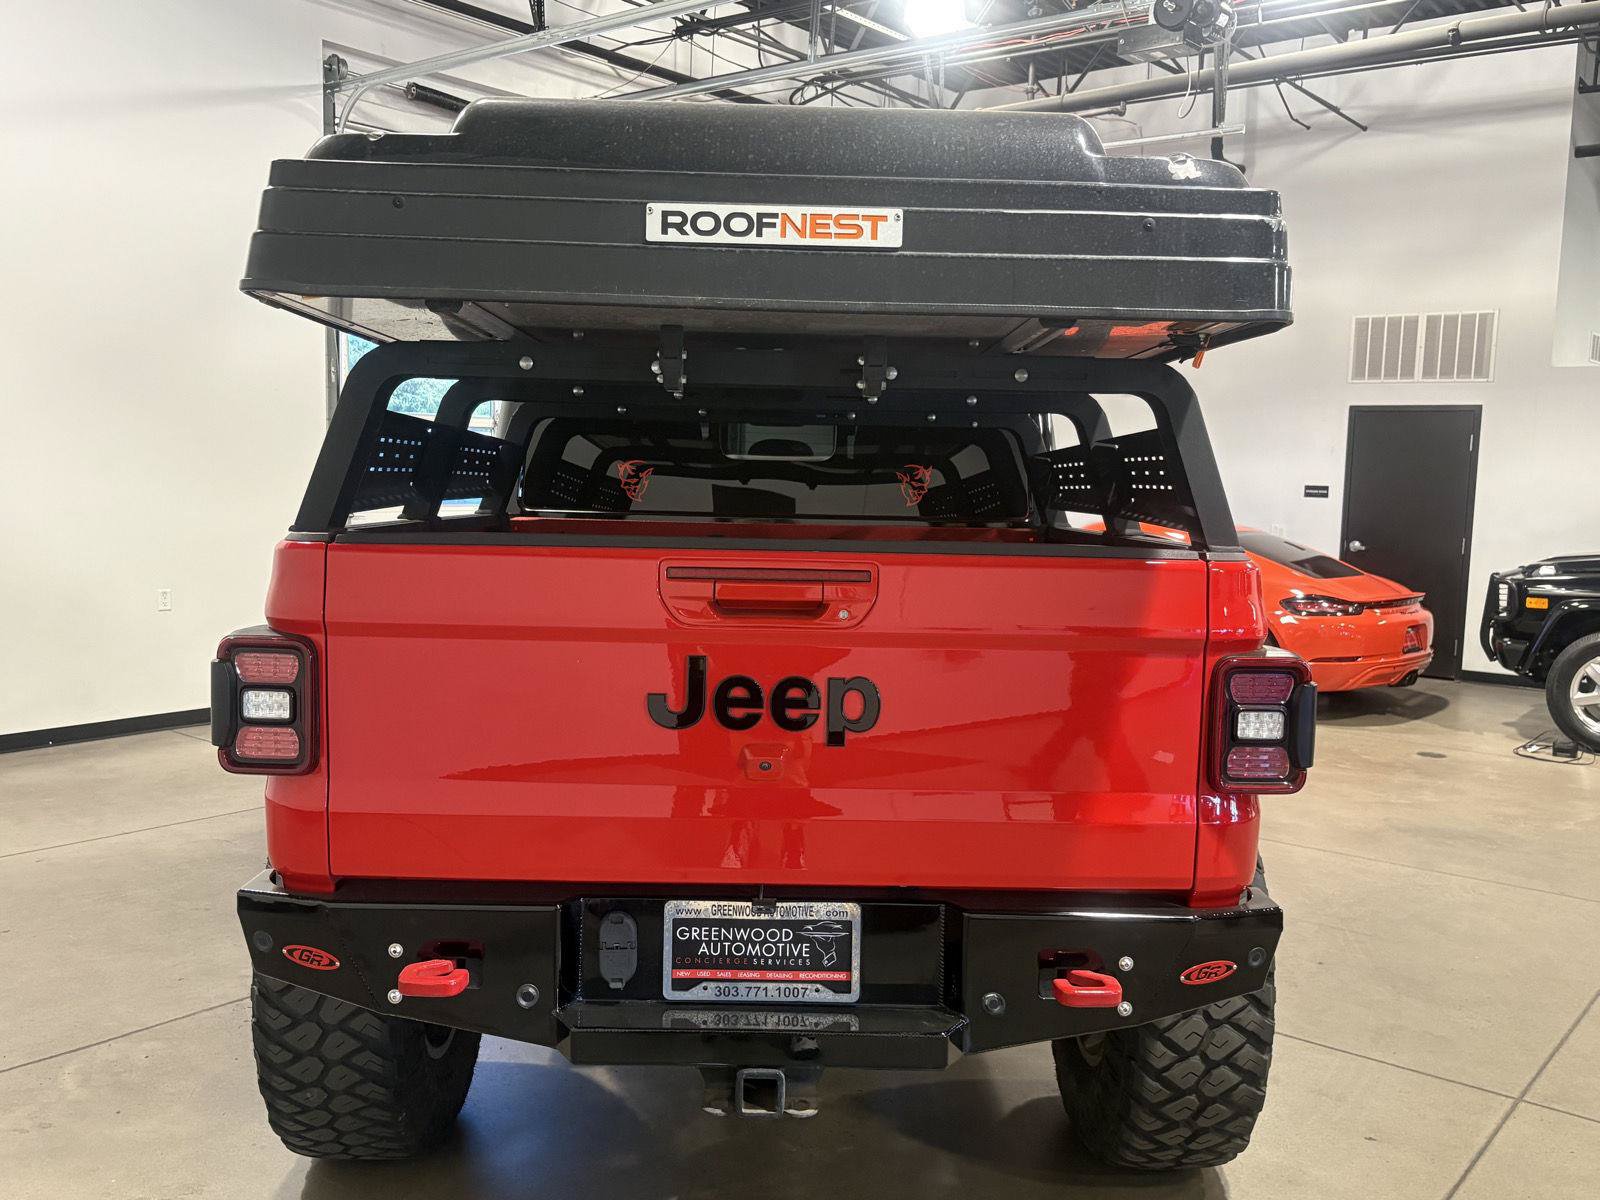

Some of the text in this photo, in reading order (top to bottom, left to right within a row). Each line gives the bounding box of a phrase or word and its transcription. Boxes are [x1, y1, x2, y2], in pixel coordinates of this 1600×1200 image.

[661, 210, 888, 241] ROOFNEST
[647, 655, 881, 747] Jeep
[676, 926, 793, 942] GREENWOOD
[697, 942, 811, 957] AUTOMOTIVE
[675, 956, 811, 966] CONCIERGE SERVICES
[714, 985, 808, 998] 303.771.1007
